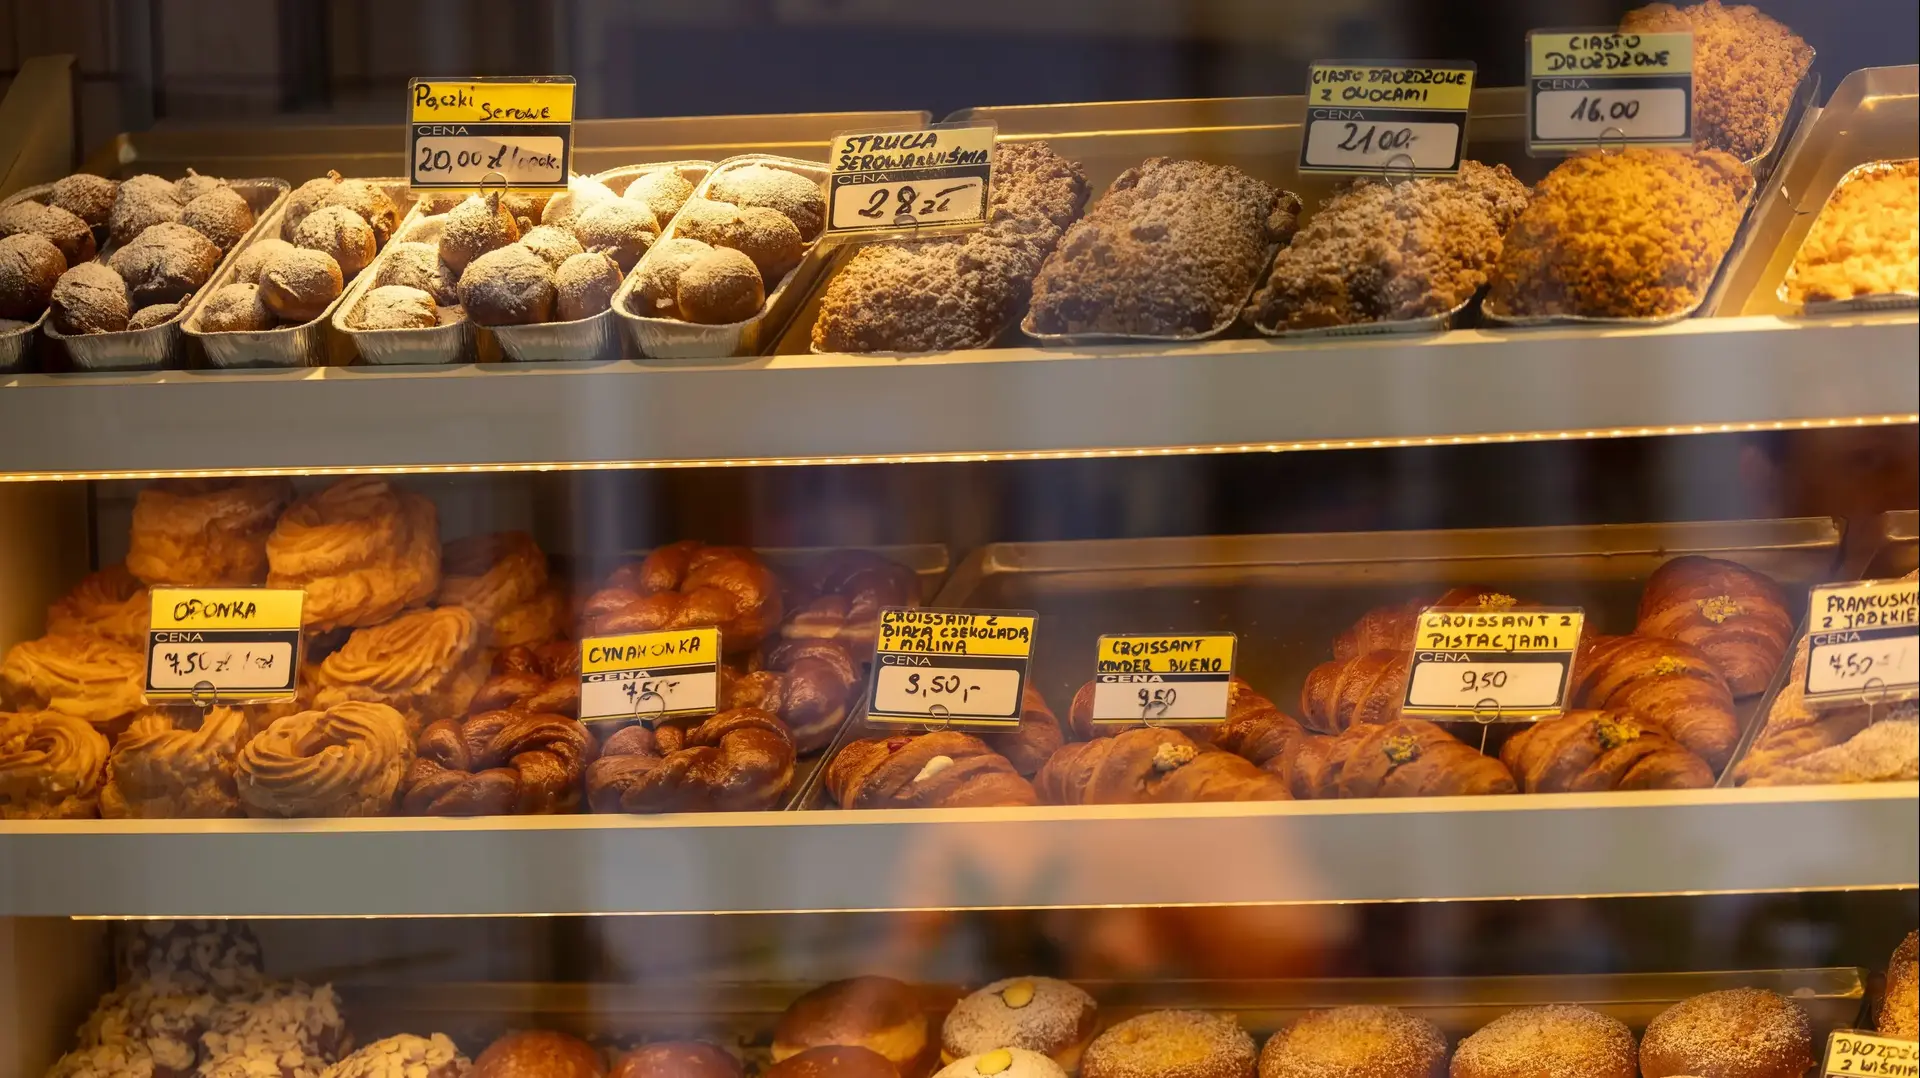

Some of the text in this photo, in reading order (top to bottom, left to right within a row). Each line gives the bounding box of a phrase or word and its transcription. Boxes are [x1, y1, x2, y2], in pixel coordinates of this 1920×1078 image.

[1570, 34, 1641, 50] CIASTO
[1312, 70, 1364, 84] CIASTO
[1538, 80, 1590, 90] CENA
[1342, 86, 1428, 102] OWOCAMI
[1313, 110, 1365, 120] CENA
[418, 126, 468, 136] CENA
[842, 133, 937, 154] STRUCLA
[419, 147, 482, 174] 20,00
[837, 173, 889, 184] CENA
[858, 186, 918, 217] 28
[1827, 592, 1919, 612] FRANCUSKI
[883, 611, 976, 626] CROISSANT
[1426, 615, 1549, 628] CROISSANT
[155, 633, 204, 642] CENA
[940, 626, 1029, 644] CZEKOLADĄ
[1814, 632, 1860, 645] CENA
[900, 638, 967, 655] MALINĄ
[1113, 639, 1206, 656] CROISSANT
[1427, 633, 1558, 653] PISTACJAMI
[882, 655, 932, 666] CENA
[1419, 652, 1471, 662] CENA
[1098, 658, 1222, 673] KINDER BUENO
[588, 671, 650, 682] CENA
[1102, 675, 1164, 683] CENA
[1460, 670, 1507, 692] 9,50
